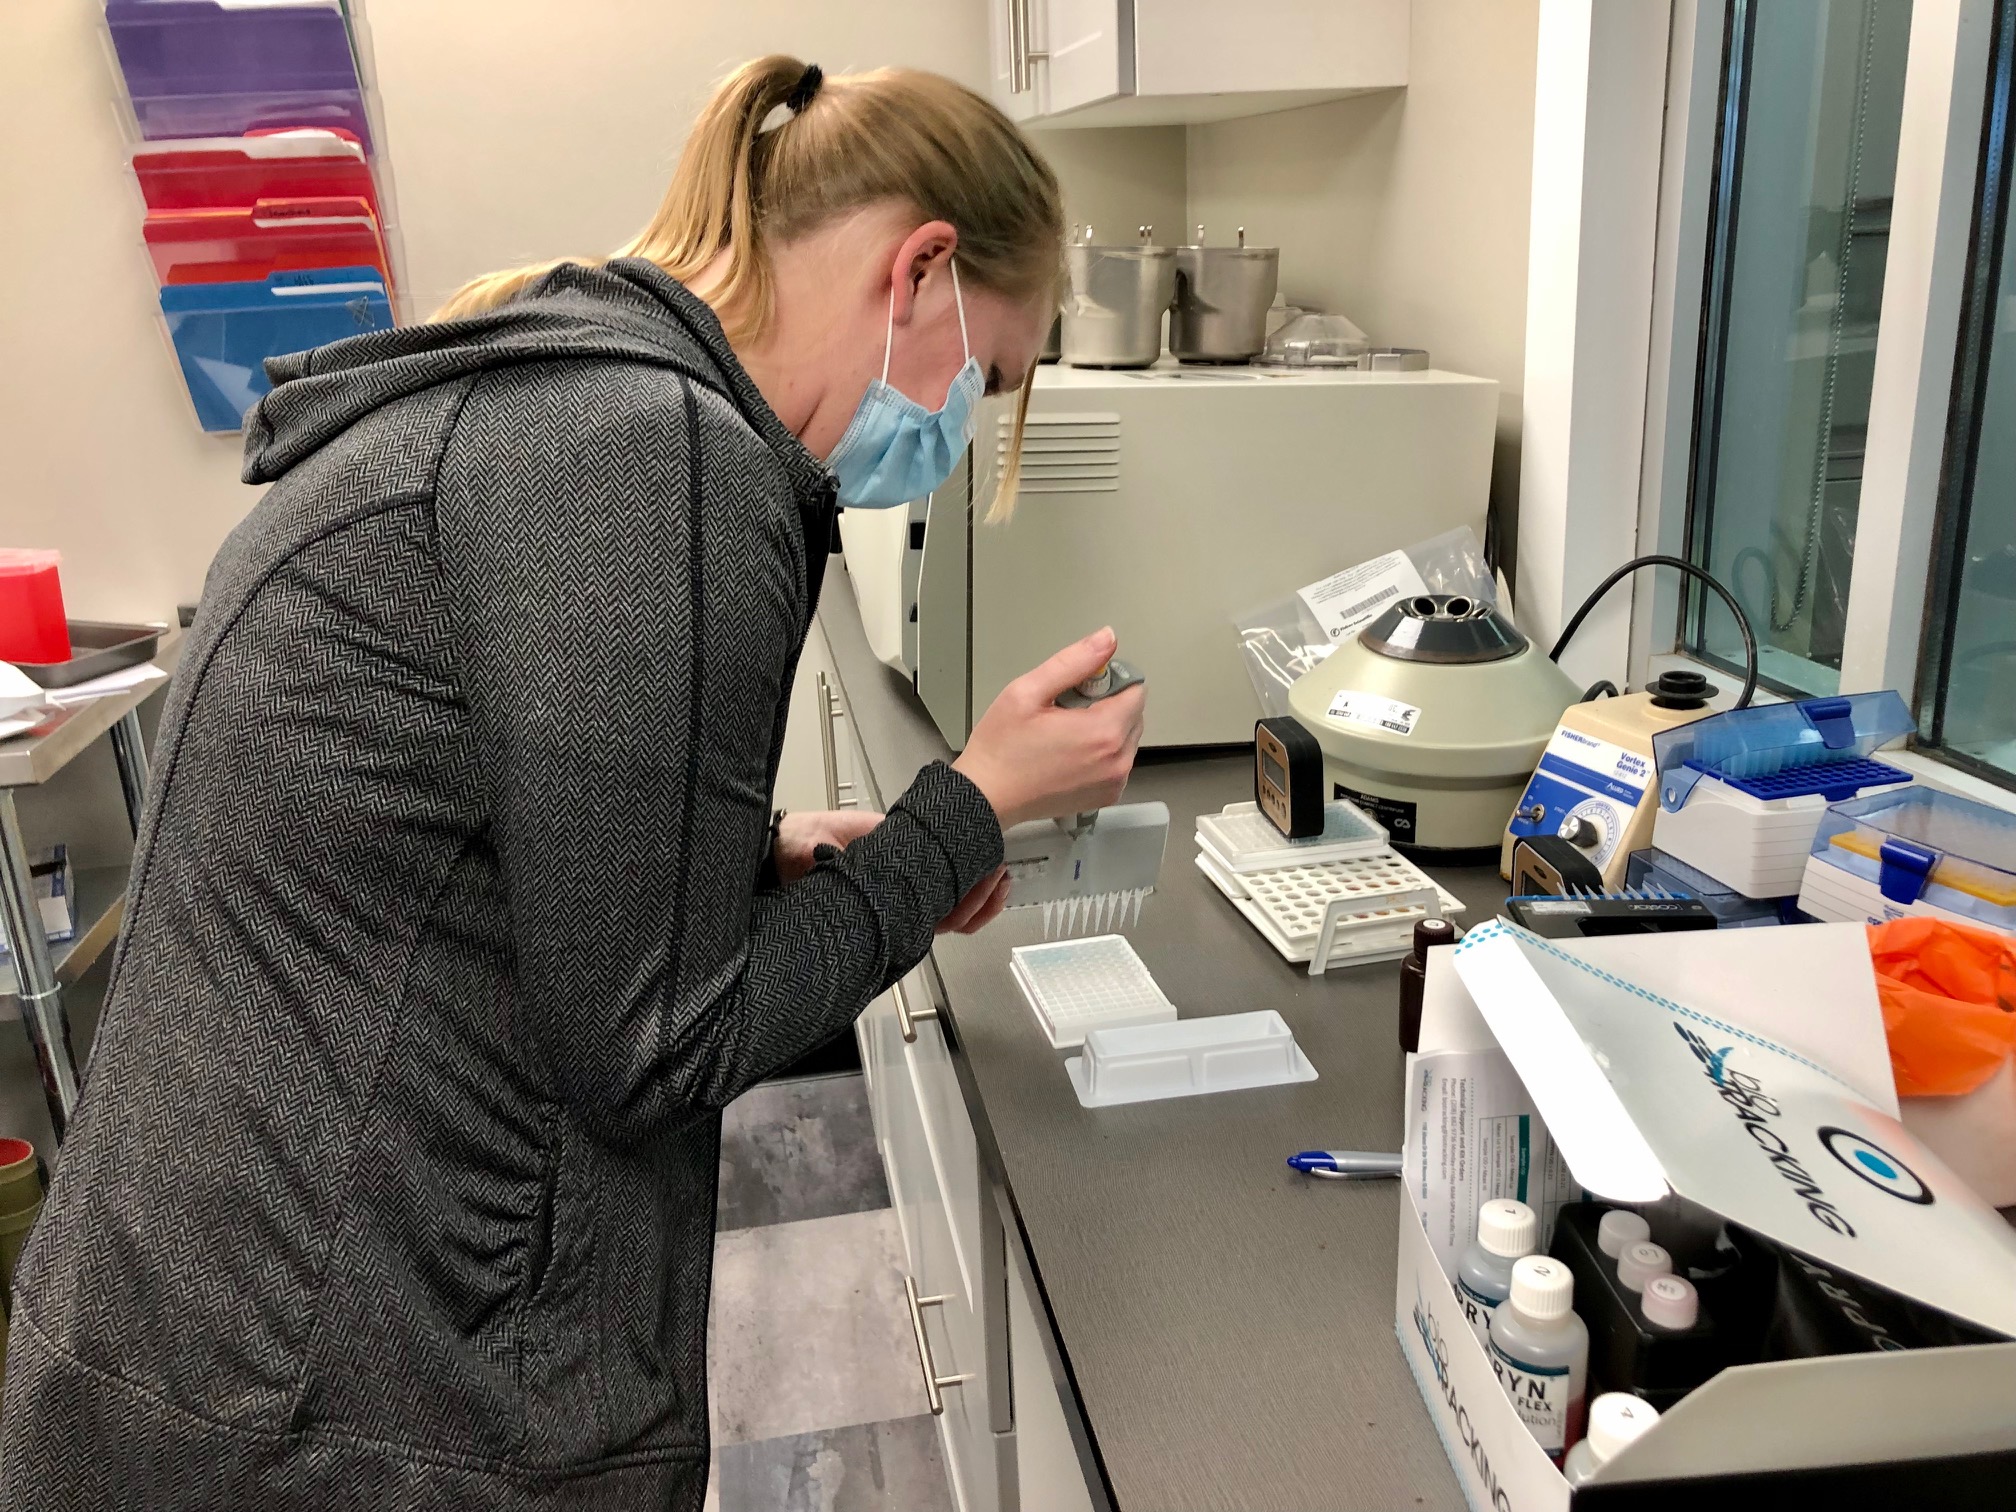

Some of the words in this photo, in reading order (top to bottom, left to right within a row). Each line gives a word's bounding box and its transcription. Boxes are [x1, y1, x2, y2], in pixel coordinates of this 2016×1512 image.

[1621, 752, 1646, 768] Vortex
[1616, 760, 1639, 775] Genie
[1640, 769, 1647, 778] 2
[1360, 793, 1380, 804] ADAMS
[1533, 1265, 1551, 1277] 2
[1489, 1354, 1546, 1400] RYN
[1517, 1396, 1552, 1412] FLEX
